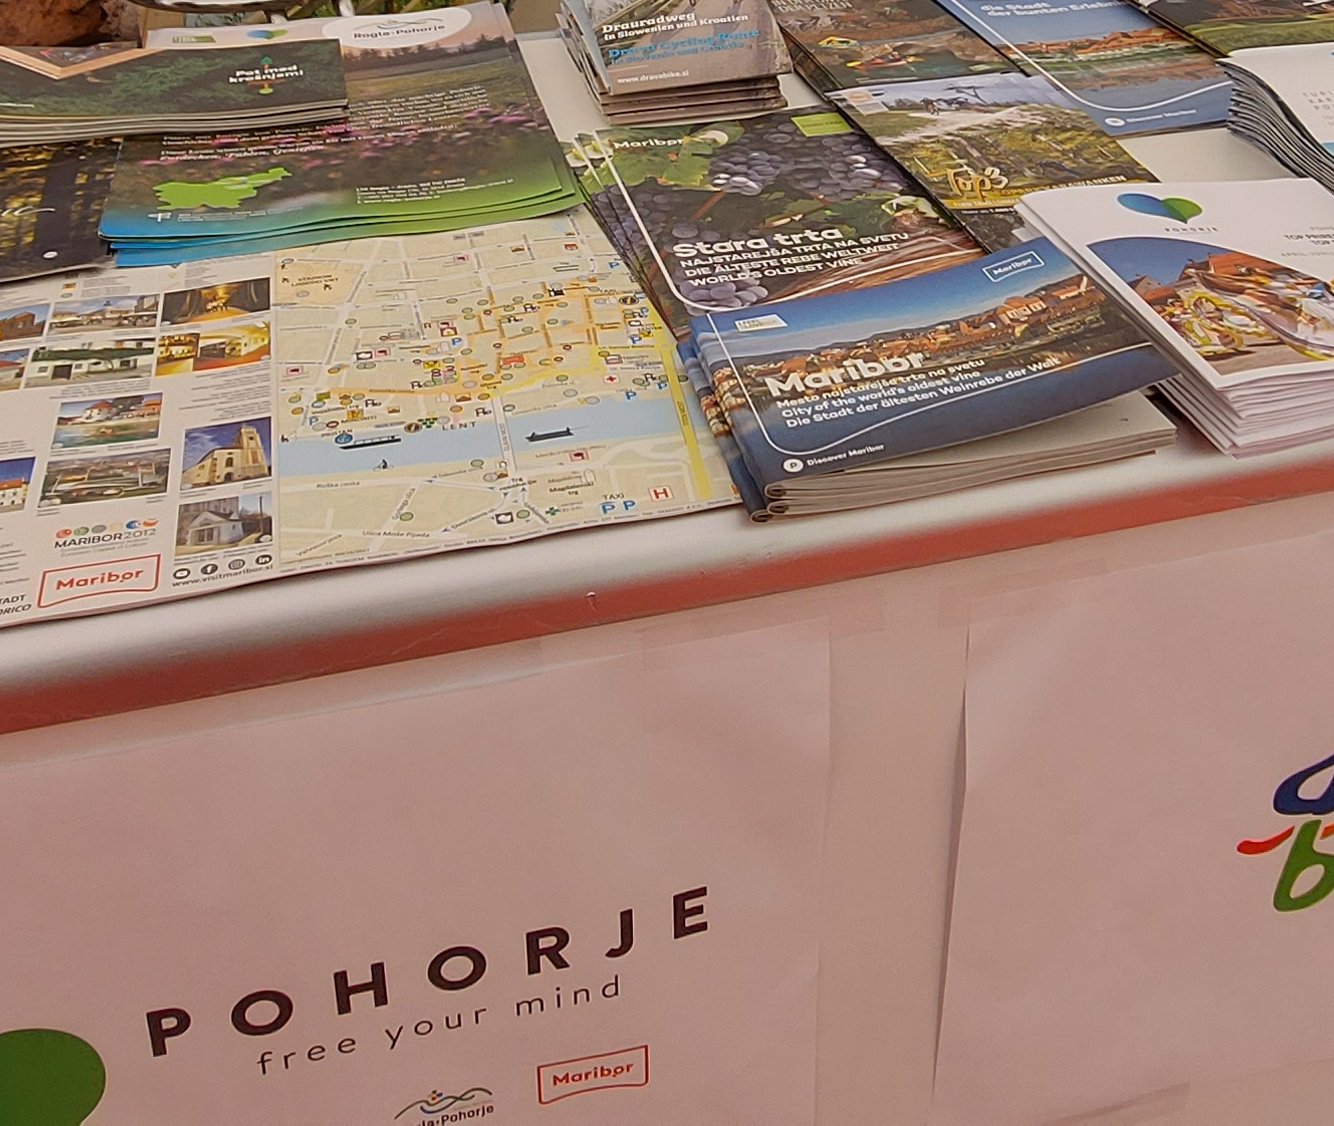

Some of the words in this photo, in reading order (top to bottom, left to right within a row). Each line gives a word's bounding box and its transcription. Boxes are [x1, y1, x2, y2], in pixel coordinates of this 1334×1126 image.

[602, 12, 695, 33] Drauradweg
[618, 24, 674, 38] Slowenien
[676, 20, 697, 29] und
[700, 14, 748, 25] Kroatien
[236, 69, 261, 77] Pot
[265, 65, 298, 74] med
[618, 70, 689, 83] www.dravabike.si
[614, 136, 686, 150] Maribor
[672, 238, 767, 259] Stara
[774, 228, 841, 246] trta
[679, 244, 792, 268] NAJSTAREJŠA
[793, 243, 834, 255] TRTA
[836, 238, 858, 249] NA
[860, 232, 909, 245] SVETU
[684, 265, 712, 277] DIE
[714, 256, 779, 274] ÄLTESTE
[782, 251, 824, 266] REBE
[826, 242, 900, 261] WELTWEIT
[690, 273, 764, 287] WORLD'S
[767, 265, 824, 280] OLDEST
[826, 258, 863, 271] VINE
[766, 352, 924, 398] Maribor
[777, 394, 819, 409] Mesto
[823, 378, 898, 401] najstarejša
[898, 370, 926, 386] trta
[928, 367, 946, 379] na
[949, 358, 985, 372] svetu
[782, 406, 814, 419] City
[815, 401, 831, 411] of
[831, 397, 856, 409] the
[858, 386, 907, 403] world's
[908, 378, 950, 393] oldest
[951, 370, 980, 382] vine
[786, 417, 811, 429] Die
[813, 408, 854, 423] Stadt
[856, 402, 878, 415] der
[881, 390, 939, 409] ältesten
[939, 374, 1004, 396] Weinrebe
[1005, 367, 1027, 380] der
[1027, 356, 1061, 374] Welt
[442, 421, 477, 431] LENT
[807, 453, 848, 468] Discover
[849, 443, 886, 458] Maribor
[603, 492, 625, 500] TAXI
[653, 488, 669, 499] H
[56, 569, 144, 591] Maribor
[172, 565, 274, 587] www.visitmaribor.si
[144, 886, 710, 1058] POHORJE
[256, 1037, 358, 1076] free
[384, 1003, 488, 1053] your
[514, 976, 621, 1018] mind
[552, 1063, 634, 1086] Maribor
